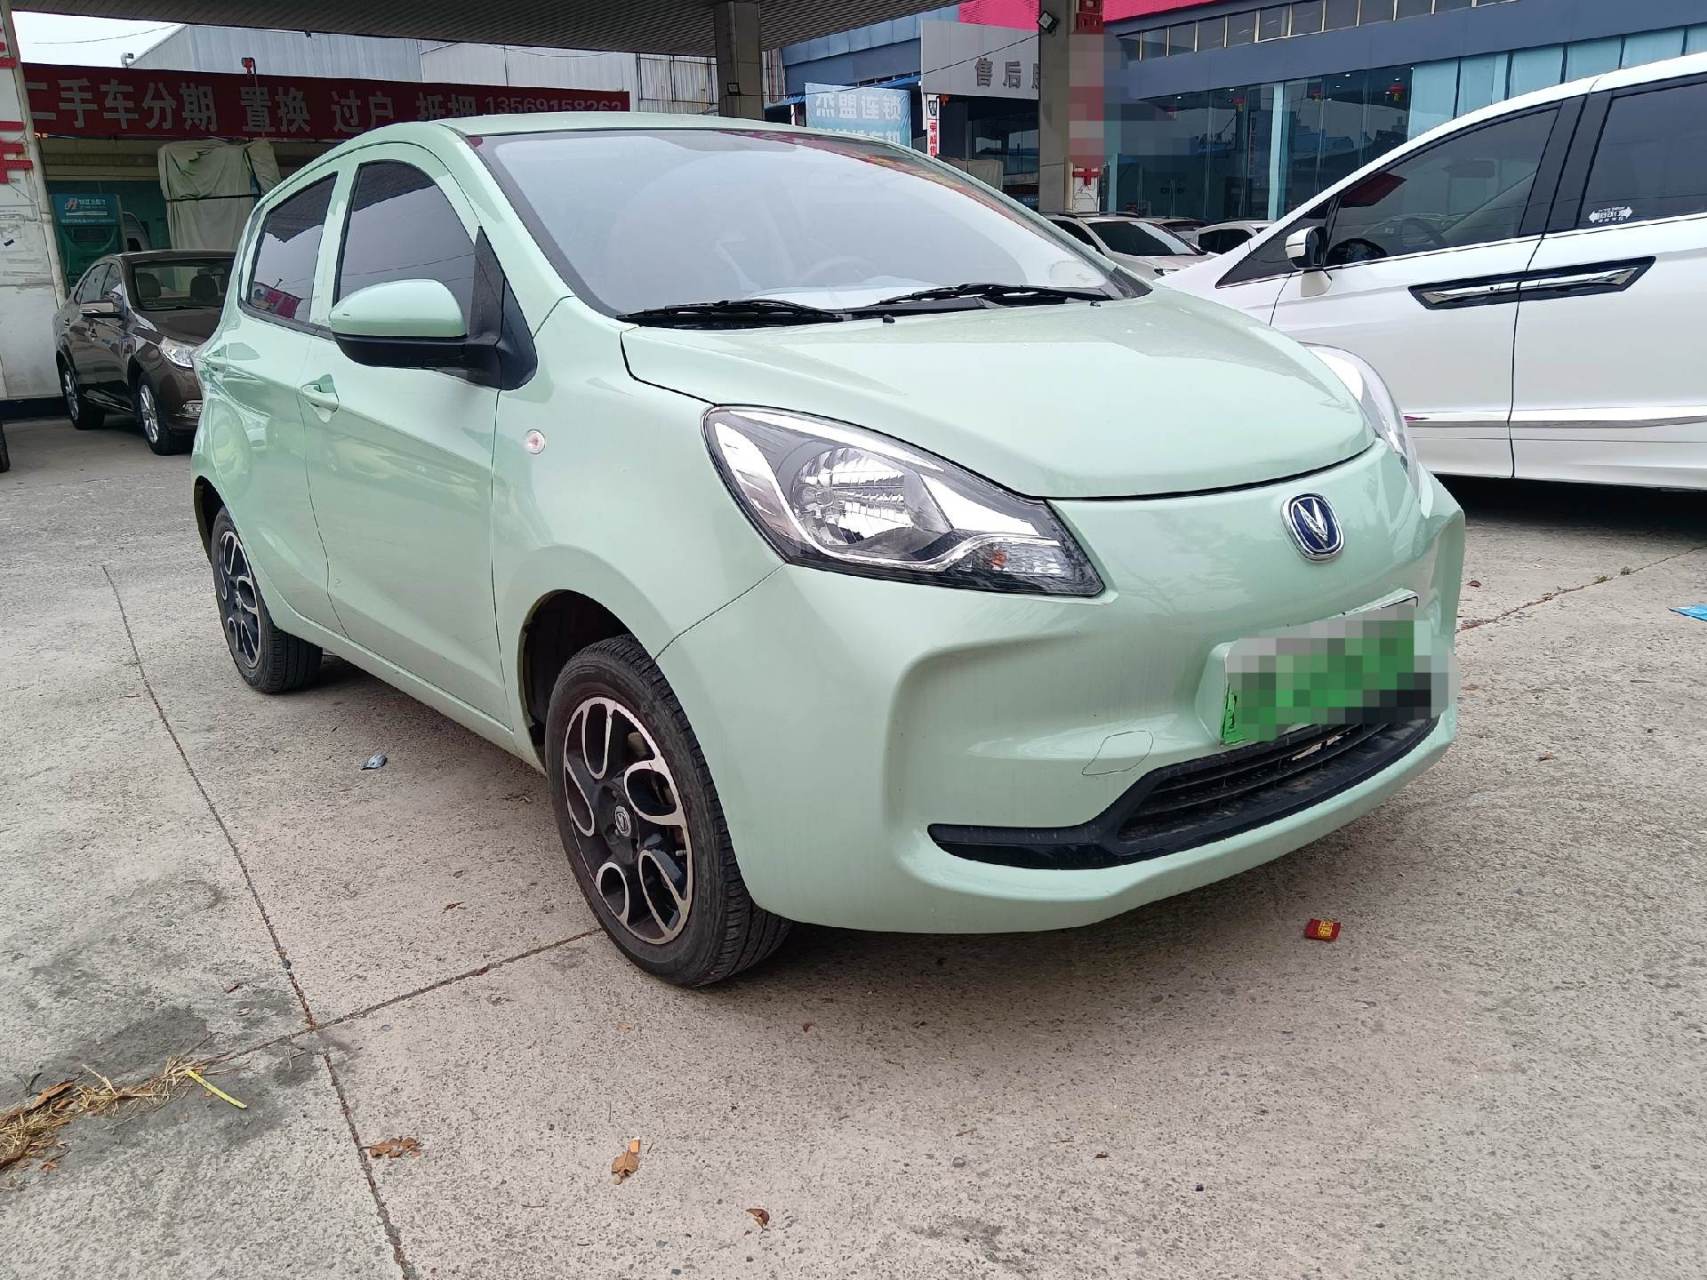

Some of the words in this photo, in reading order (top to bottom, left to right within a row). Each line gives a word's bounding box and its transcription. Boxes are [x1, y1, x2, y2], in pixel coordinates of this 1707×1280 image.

[25, 78, 217, 131] 二手车分期
[240, 86, 311, 133] 置换
[331, 89, 394, 132] 过户
